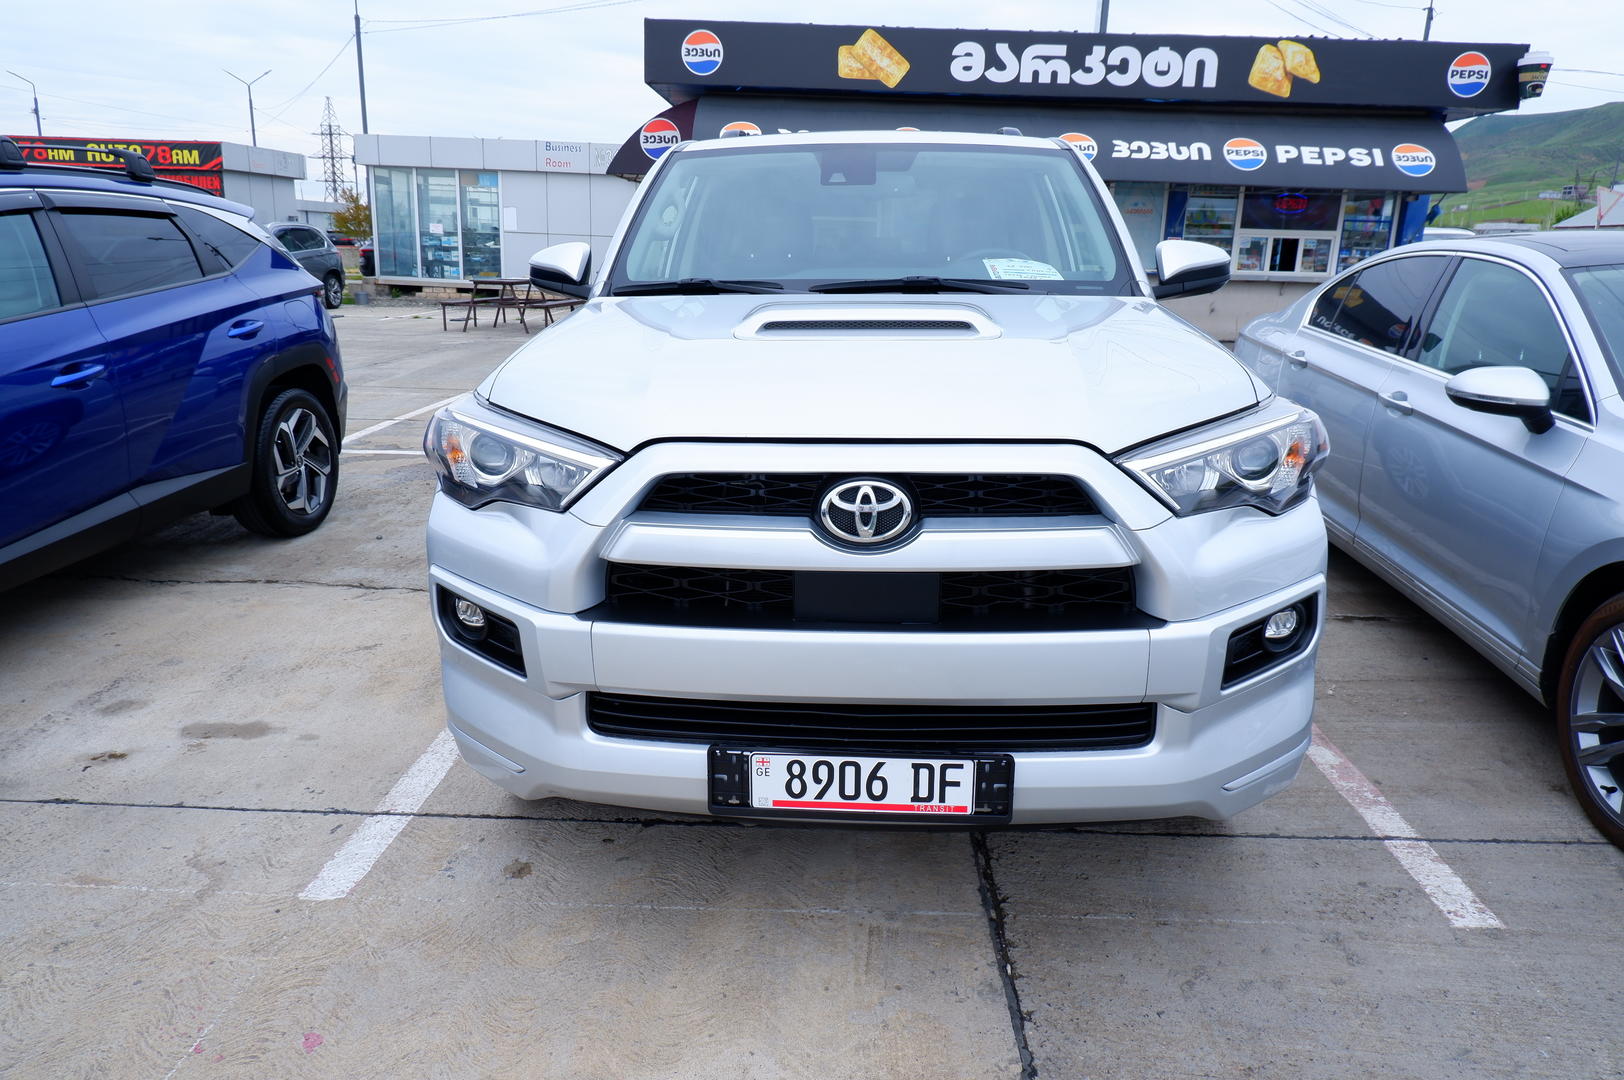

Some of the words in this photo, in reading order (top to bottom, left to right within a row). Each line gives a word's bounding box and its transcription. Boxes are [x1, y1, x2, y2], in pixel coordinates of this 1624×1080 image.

[684, 48, 721, 58] პეპსი
[950, 41, 1219, 88] მარკეტი
[1450, 69, 1489, 80] PEPSI
[642, 134, 679, 144] პეპსი
[545, 141, 582, 153] Business
[1111, 139, 1212, 161] პეპსი
[1226, 148, 1265, 157] PEPSI
[1275, 145, 1385, 167] PEPSI
[545, 157, 571, 168] Room
[756, 767, 770, 777] GE
[785, 759, 889, 802] 8906
[911, 763, 964, 803] DF
[913, 804, 955, 813] TRANSIT
